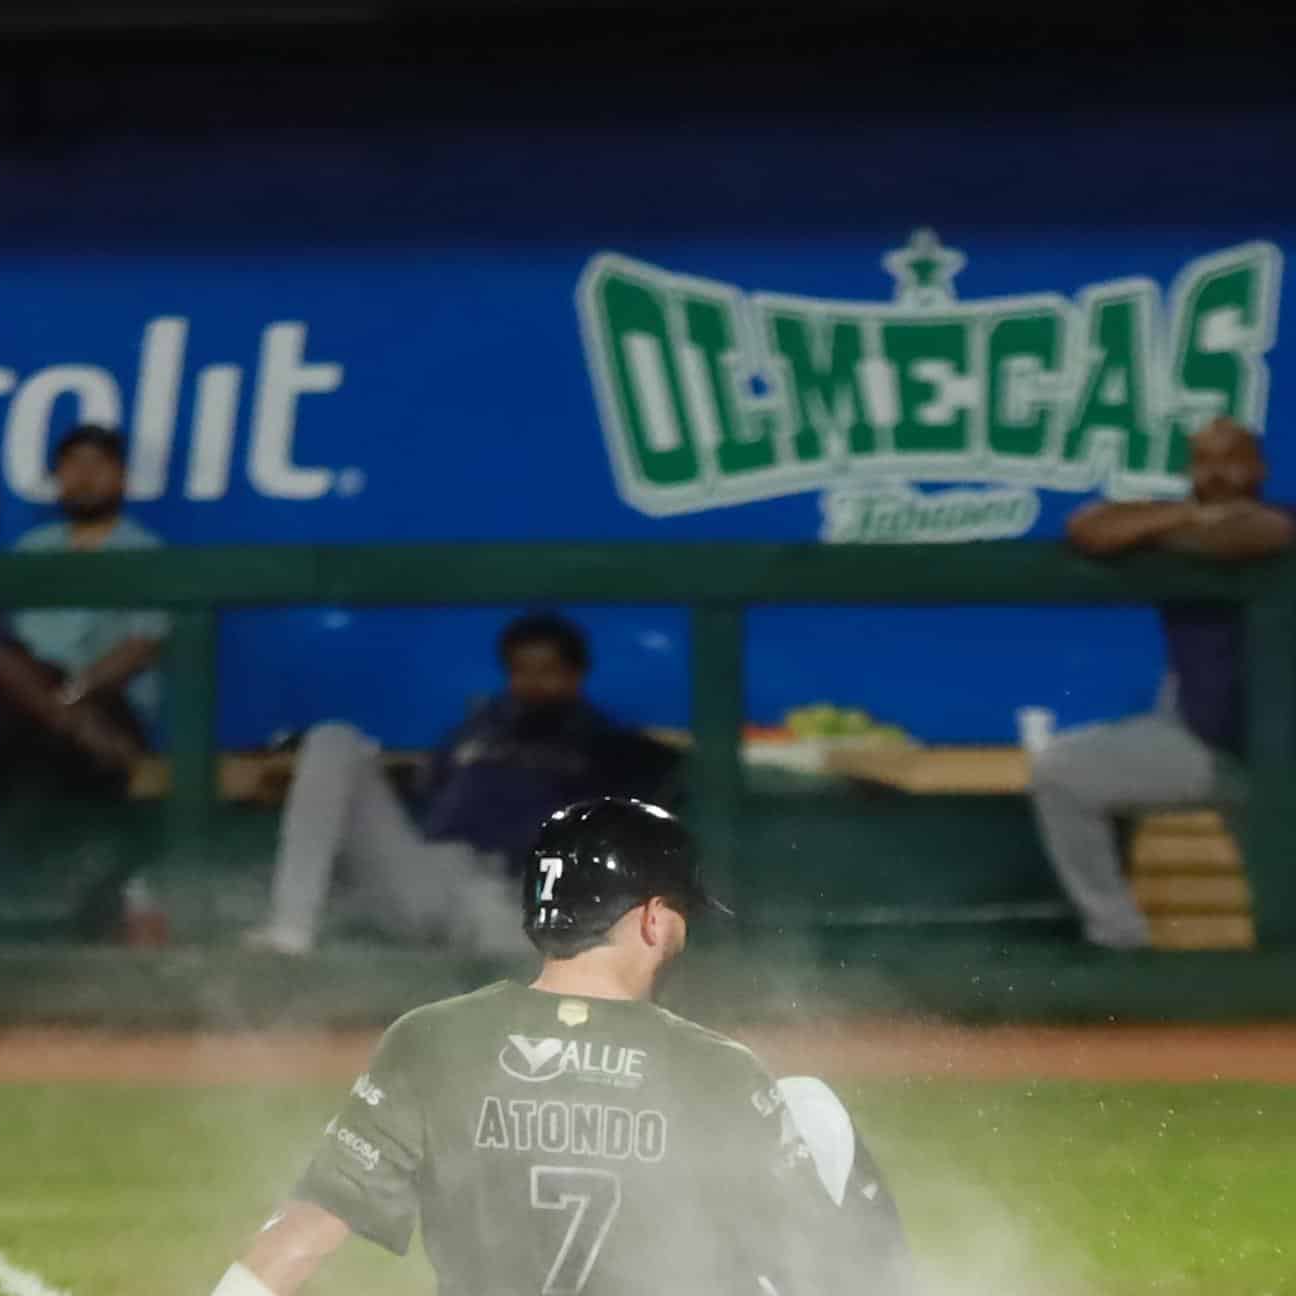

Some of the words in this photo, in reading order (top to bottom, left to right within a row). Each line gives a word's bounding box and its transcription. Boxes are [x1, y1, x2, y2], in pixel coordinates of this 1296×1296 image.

[582, 244, 1278, 508] OLMECAS
[505, 1034, 648, 1079] VALUE
[474, 1096, 667, 1161] ATONDO
[529, 1165, 622, 1296] 7
